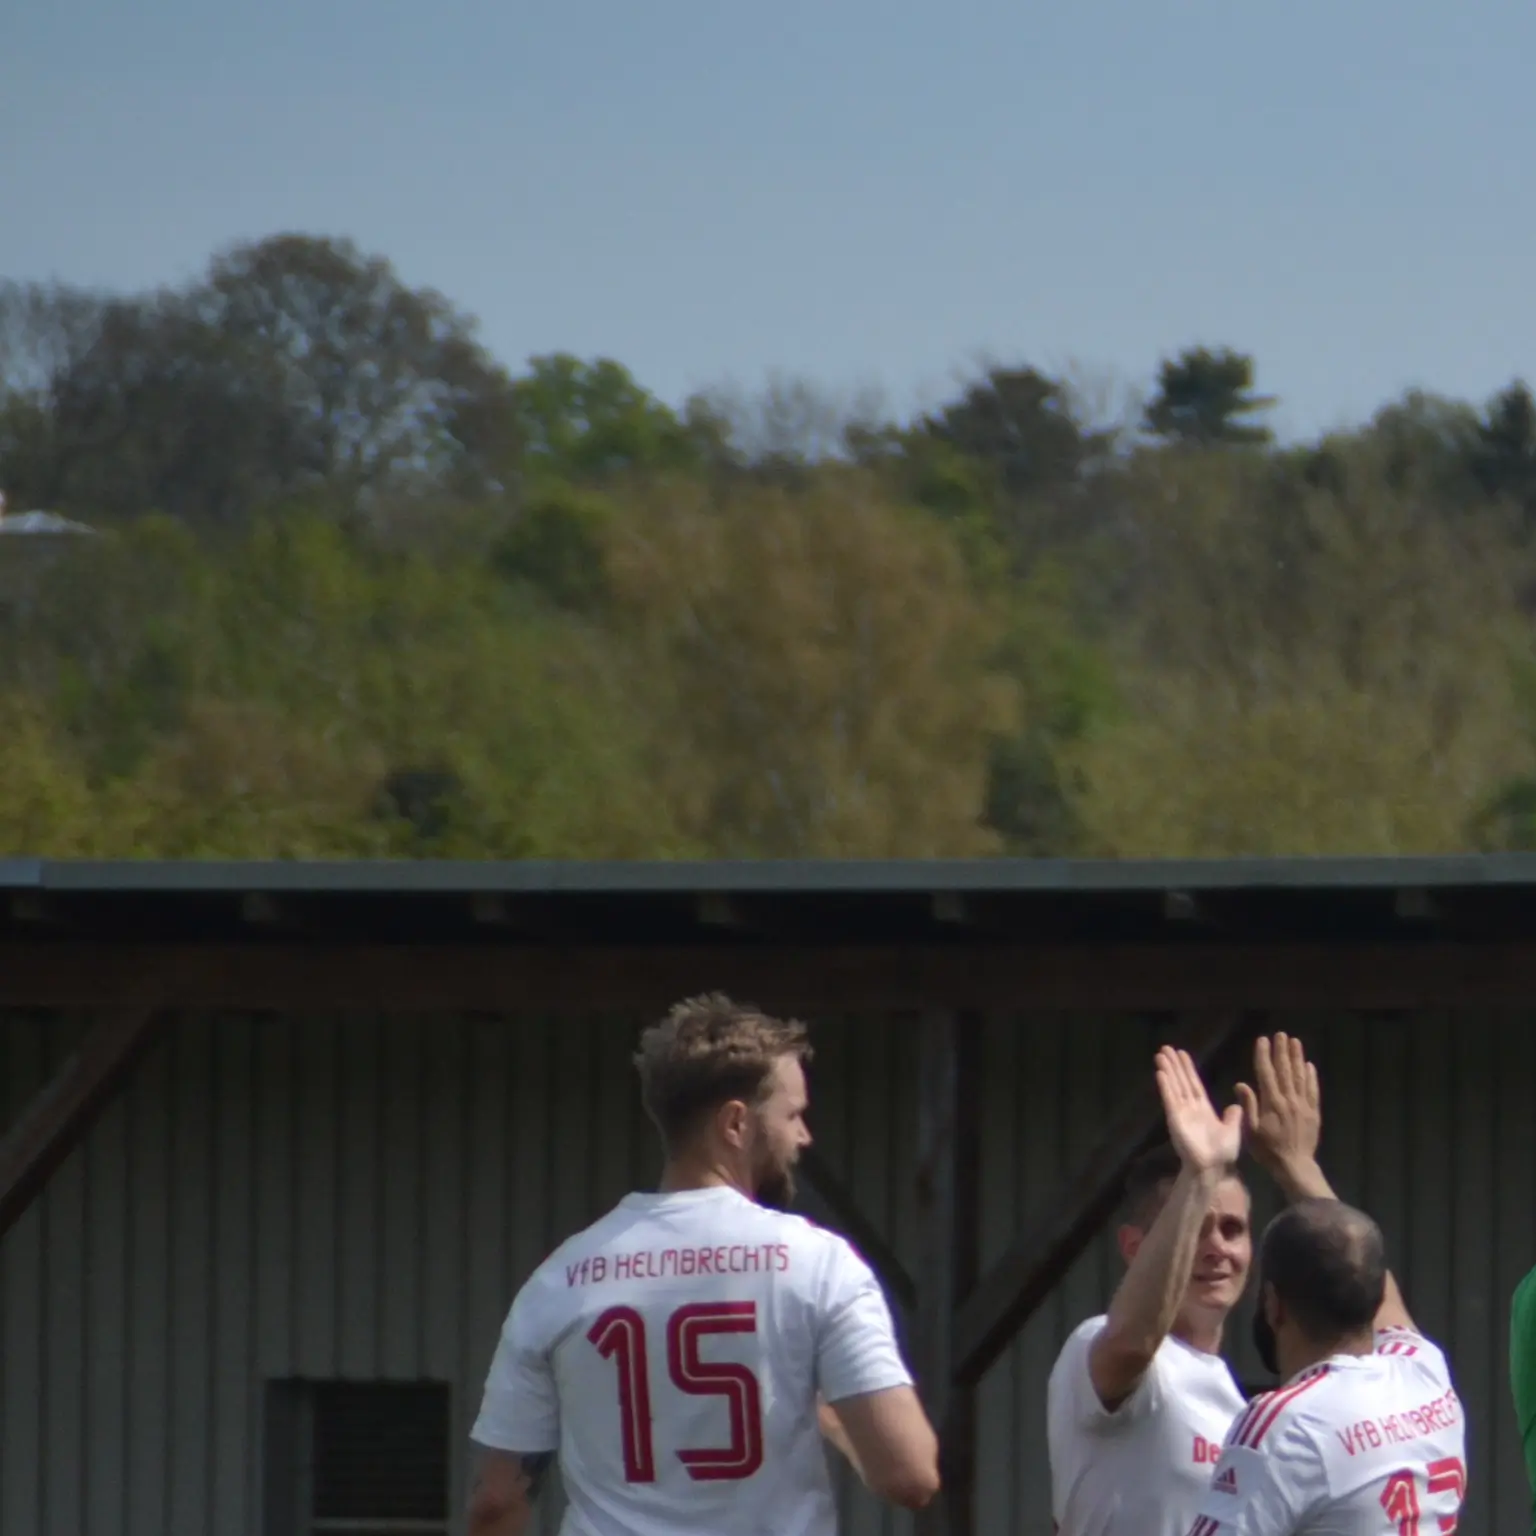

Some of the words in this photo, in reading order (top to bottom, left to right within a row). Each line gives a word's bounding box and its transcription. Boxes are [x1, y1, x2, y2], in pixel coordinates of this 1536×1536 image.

[565, 1256, 607, 1288] VfB
[614, 1244, 790, 1281] HELMBRECHTS
[586, 1301, 765, 1483] 15
[1335, 1419, 1383, 1457] VfB
